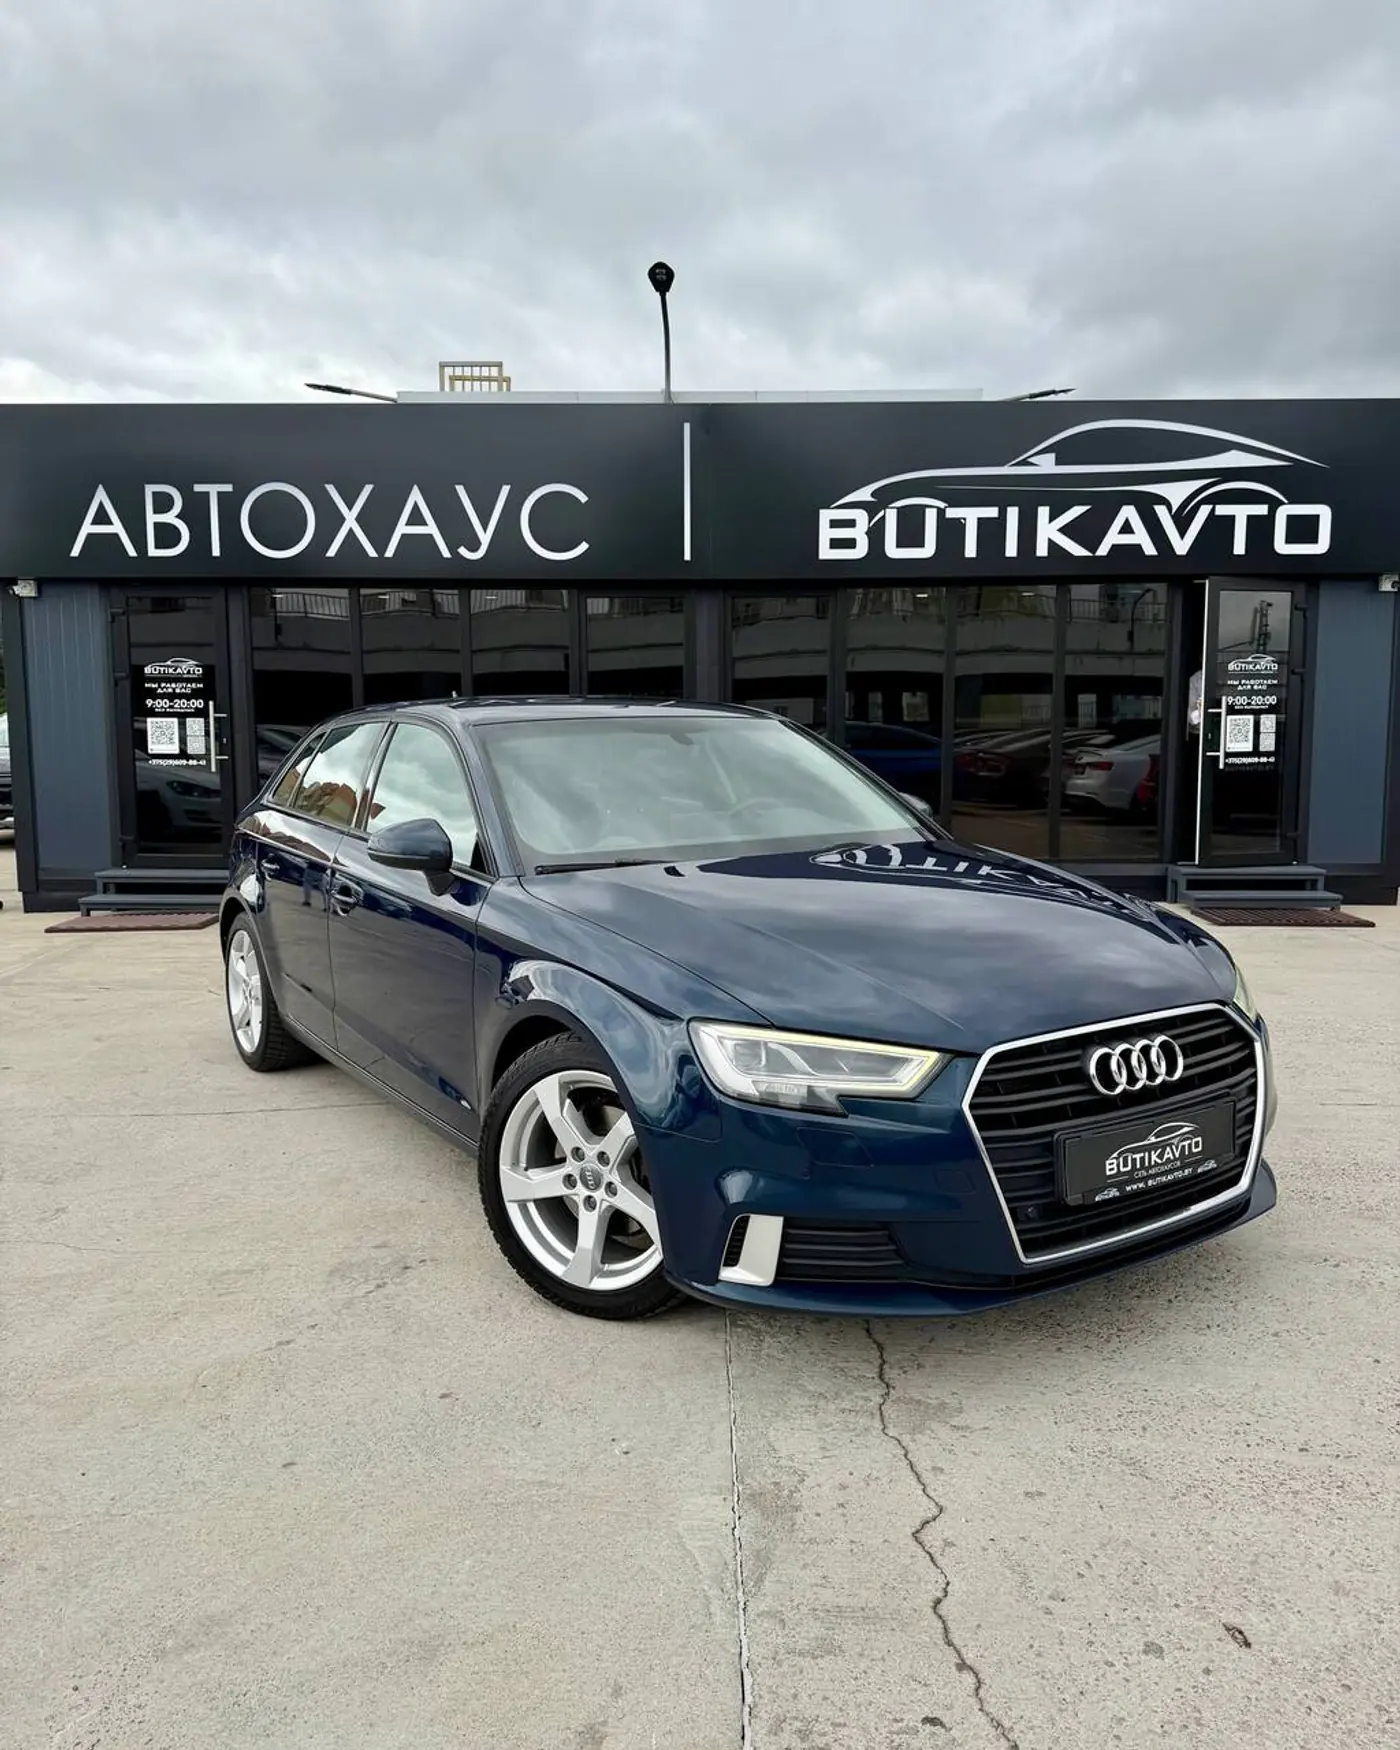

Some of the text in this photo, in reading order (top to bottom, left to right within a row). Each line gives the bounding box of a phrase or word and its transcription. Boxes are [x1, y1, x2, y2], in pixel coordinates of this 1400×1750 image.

[69, 481, 590, 561] АВТОХАУС
[818, 504, 1332, 560] BUTIKAVTO
[1227, 663, 1278, 671] BUTIKAVTO
[145, 699, 204, 708] 9:00-20:00
[1227, 696, 1277, 705] 9:00-20:00
[1105, 1137, 1203, 1176] BUTIKAVTO
